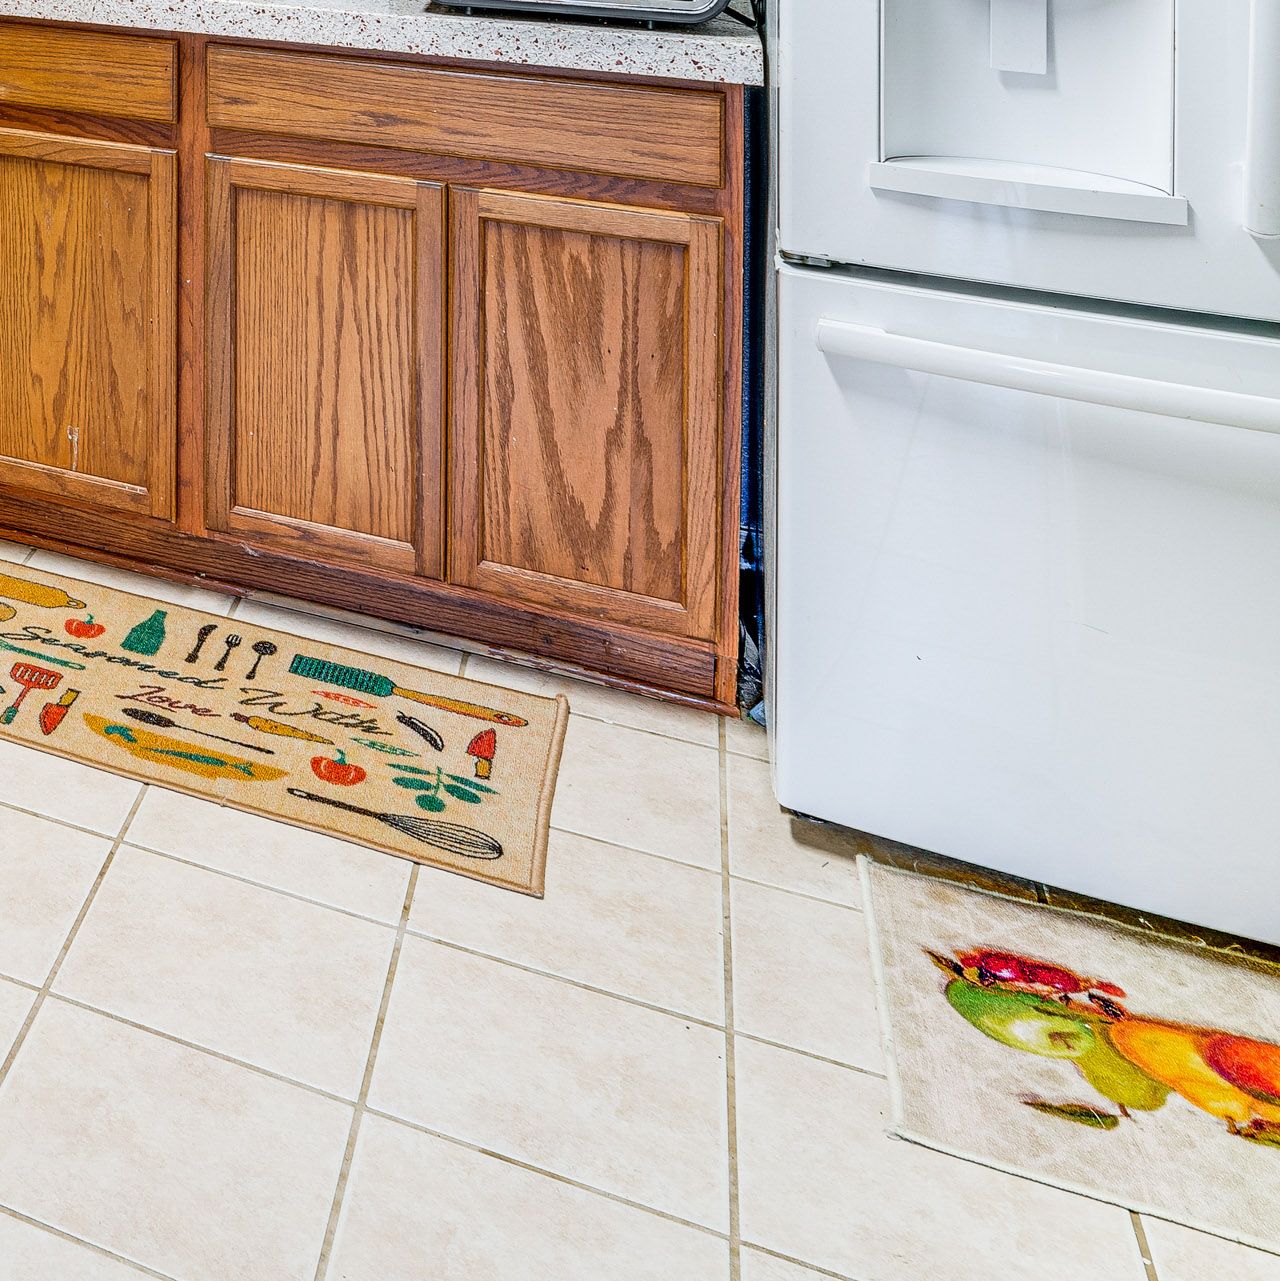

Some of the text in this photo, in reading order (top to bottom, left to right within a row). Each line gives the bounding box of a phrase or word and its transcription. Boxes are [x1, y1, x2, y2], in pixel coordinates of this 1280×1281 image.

[0, 625, 394, 736] Seasoned With
[114, 685, 225, 718] Love
